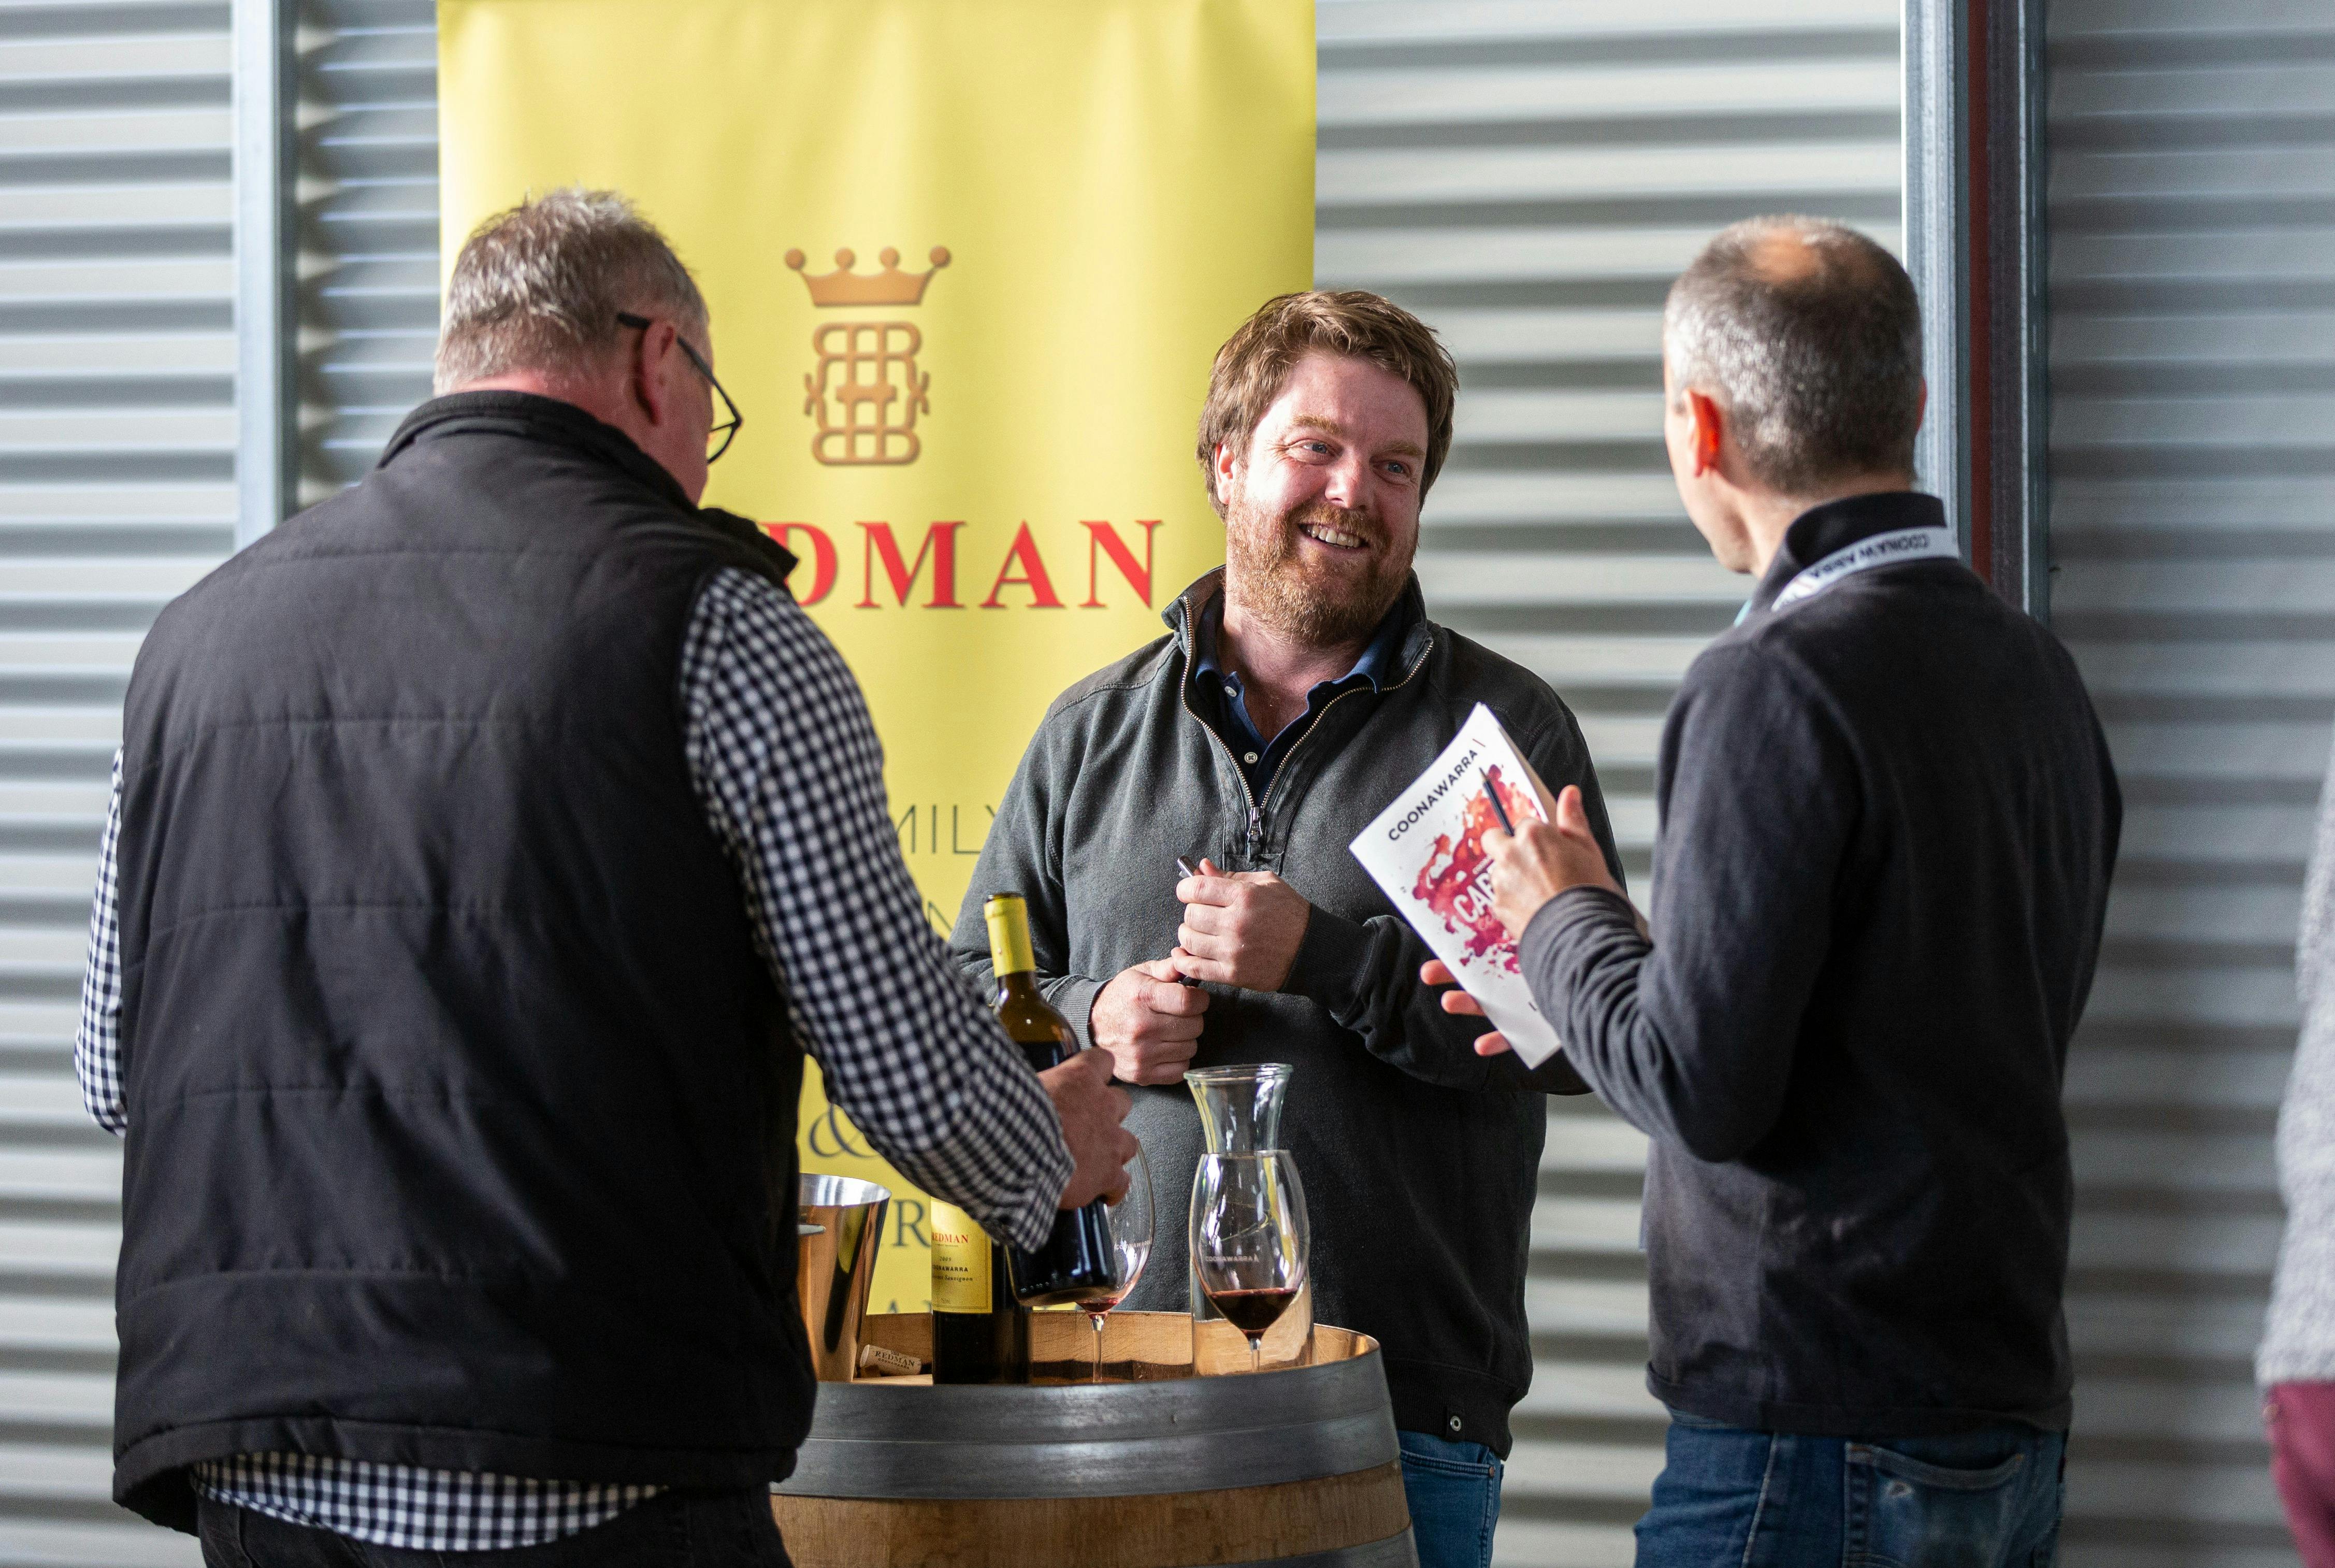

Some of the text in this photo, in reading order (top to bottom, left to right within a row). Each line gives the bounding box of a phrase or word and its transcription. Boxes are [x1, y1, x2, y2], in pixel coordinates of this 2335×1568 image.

[1389, 749, 1478, 841] COONAWARRA
[932, 1232, 968, 1243] REDMAN
[875, 1350, 915, 1366] REDMAN
